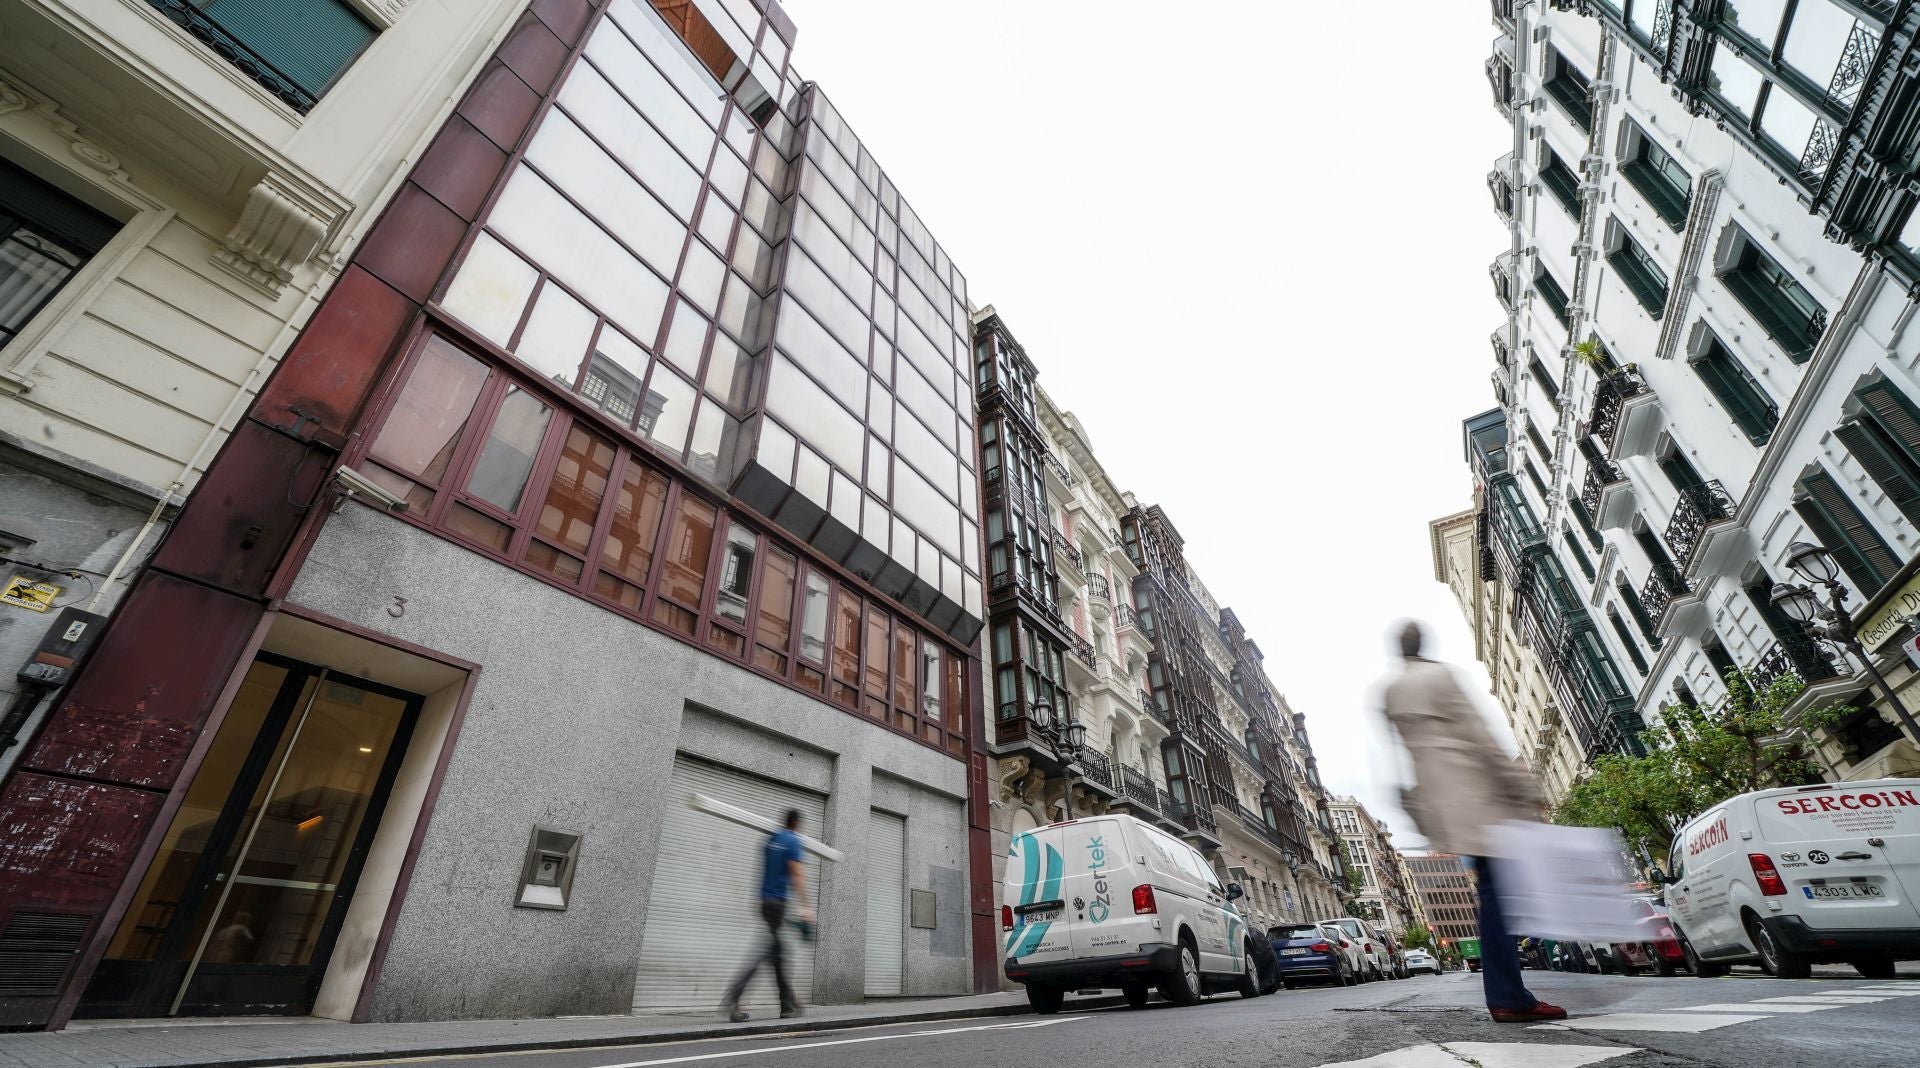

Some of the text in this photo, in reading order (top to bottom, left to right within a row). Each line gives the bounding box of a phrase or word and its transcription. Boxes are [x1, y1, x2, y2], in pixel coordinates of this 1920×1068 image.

[3, 595, 43, 609] PROSEGUR
[387, 595, 409, 618] 3
[1862, 608, 1904, 646] Gestoría
[1809, 852, 1828, 862] 26
[1086, 836, 1110, 907] zertek
[1814, 886, 1880, 898] 4303 LWC
